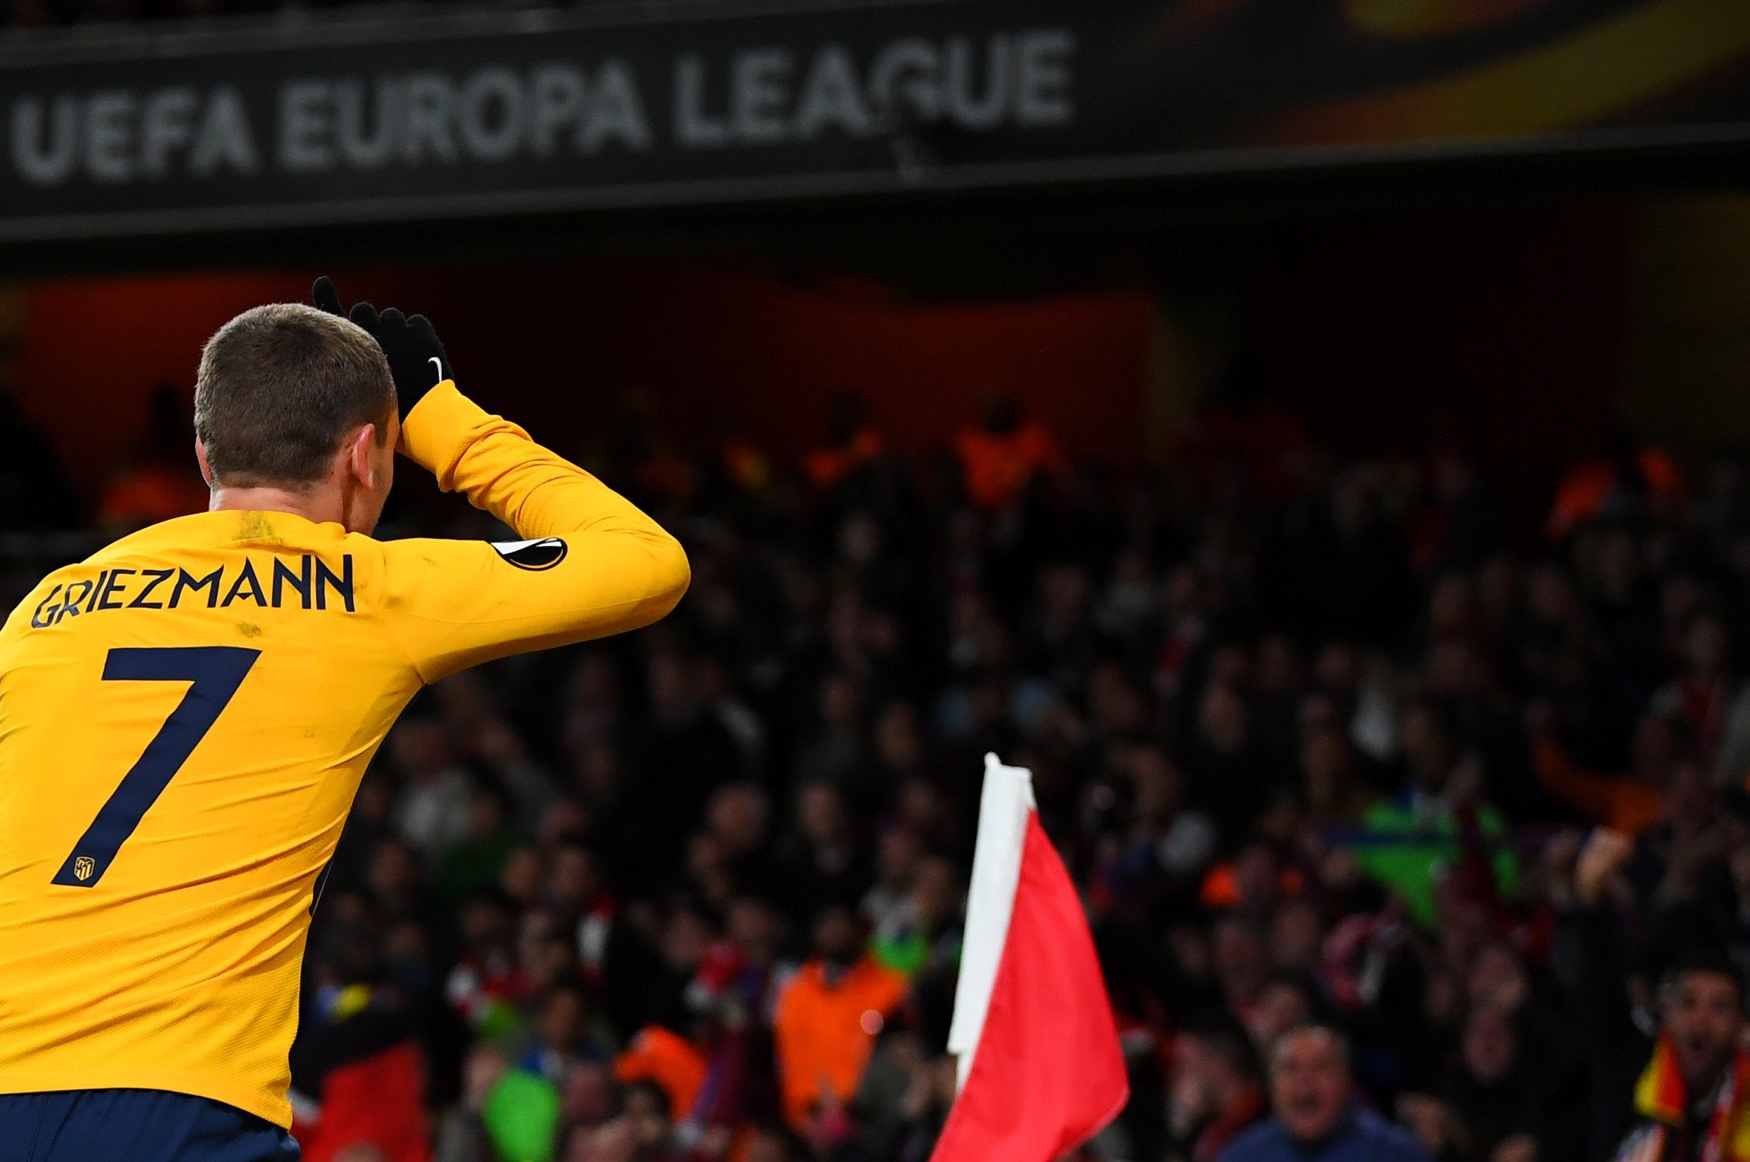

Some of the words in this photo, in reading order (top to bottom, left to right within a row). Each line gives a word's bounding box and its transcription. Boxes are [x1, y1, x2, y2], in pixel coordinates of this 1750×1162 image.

[9, 84, 255, 182] UEFA
[277, 58, 649, 172] EUROPA
[672, 29, 1075, 148] LEAGUE
[30, 553, 355, 629] GRIEZMANN
[51, 646, 261, 888] 7
